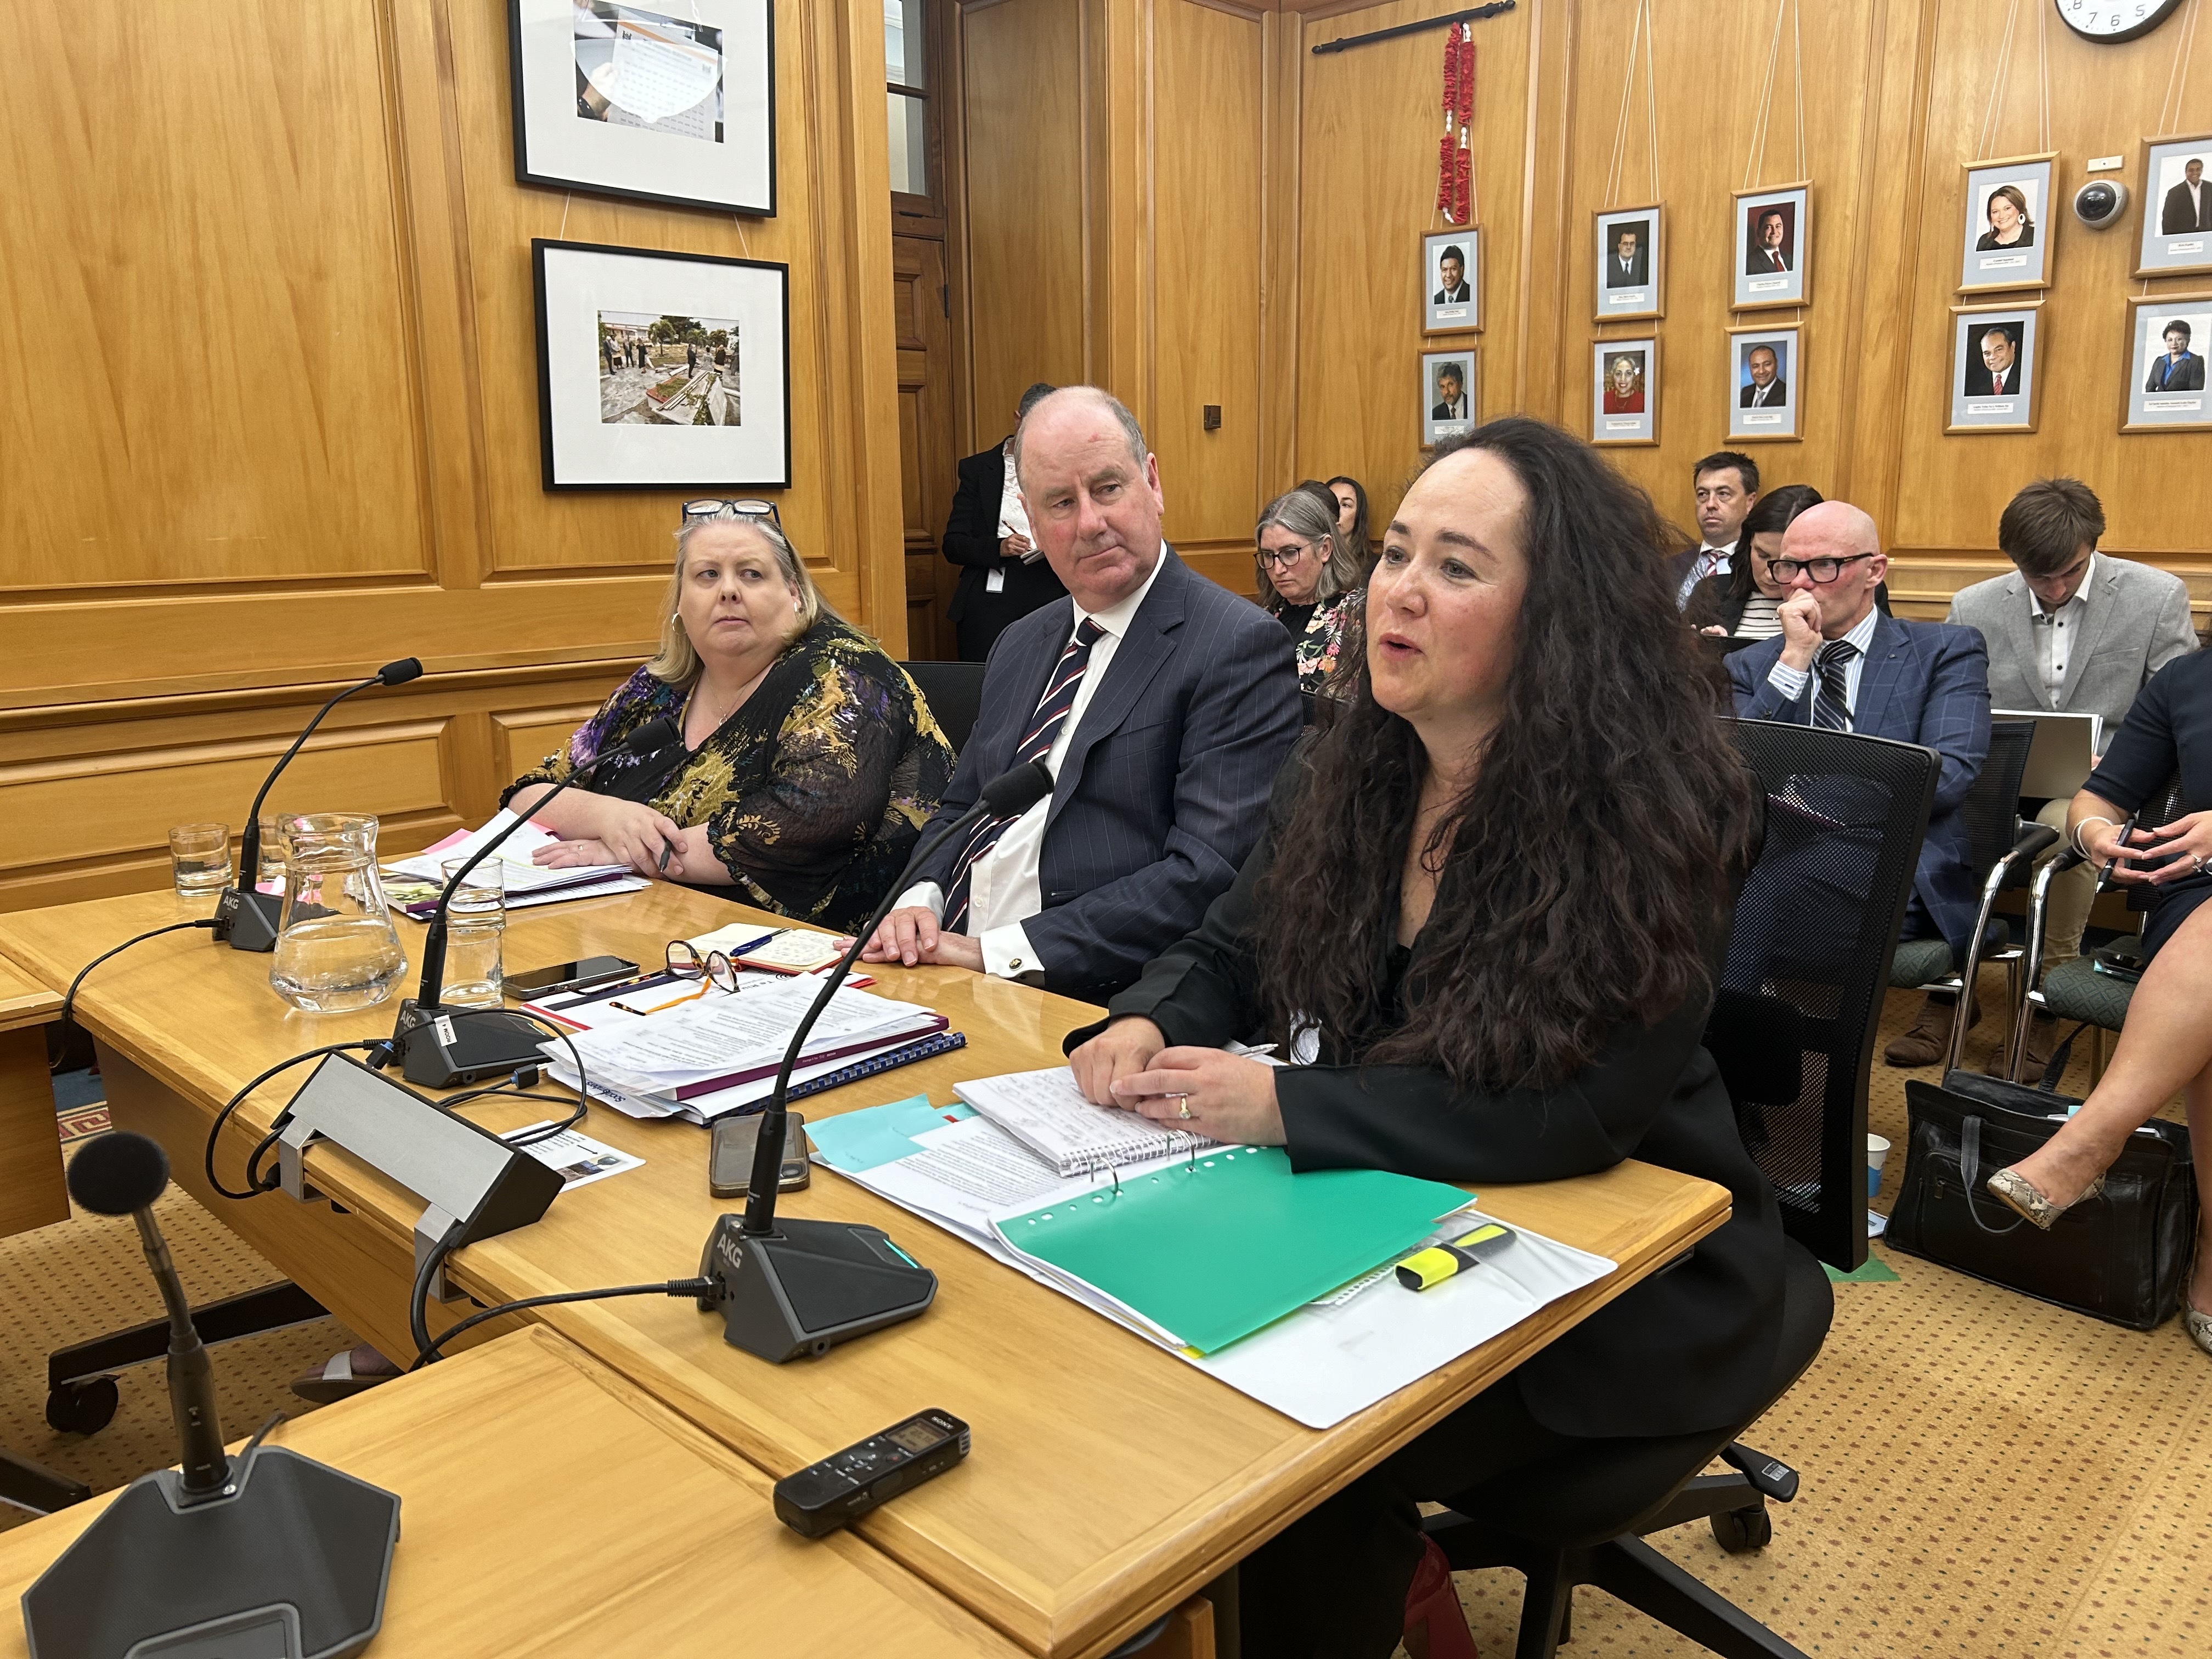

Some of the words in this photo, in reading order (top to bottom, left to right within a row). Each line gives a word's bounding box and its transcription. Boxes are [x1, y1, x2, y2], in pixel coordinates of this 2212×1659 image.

[2073, 0, 2081, 10] 8
[2135, 4, 2146, 17] 5
[2089, 12, 2097, 24] 7
[2111, 14, 2120, 26] 6
[223, 895, 240, 910] AKG
[400, 1010, 416, 1028] AKG
[443, 1028, 452, 1043] ROOM
[716, 1233, 743, 1269] AKG
[931, 1416, 954, 1430] SONY
